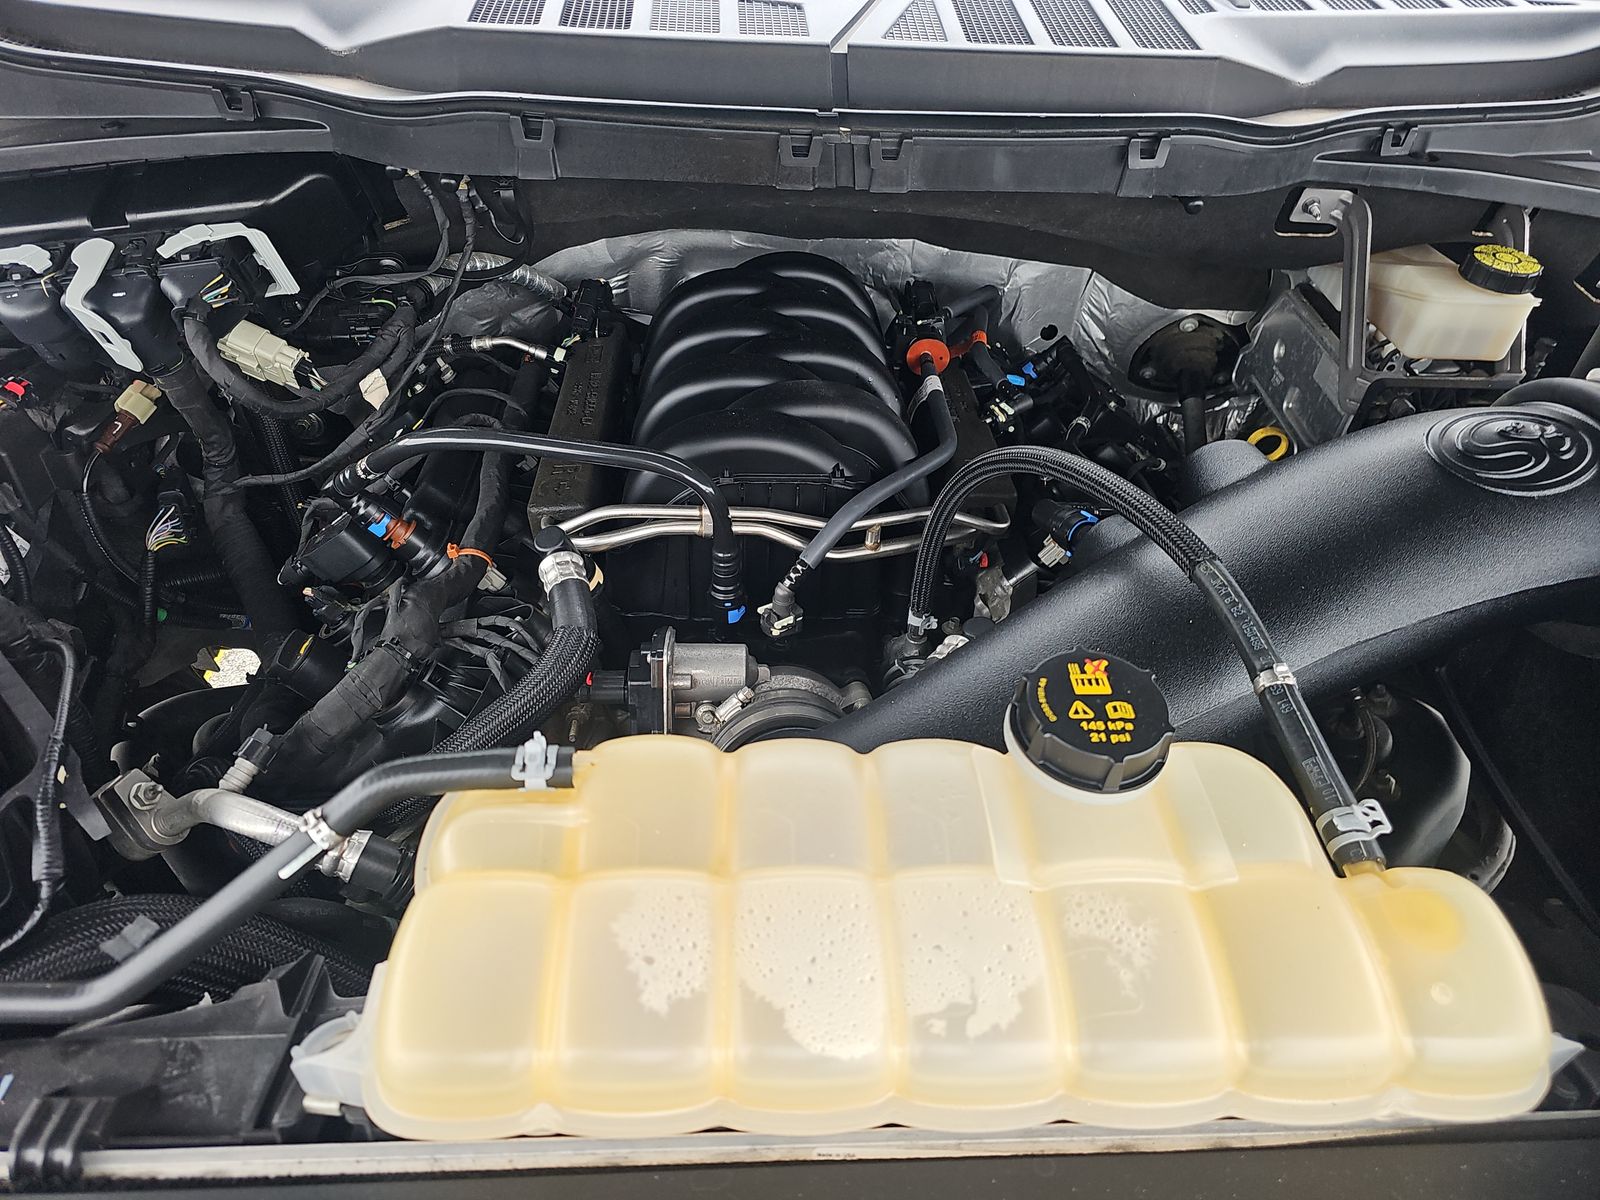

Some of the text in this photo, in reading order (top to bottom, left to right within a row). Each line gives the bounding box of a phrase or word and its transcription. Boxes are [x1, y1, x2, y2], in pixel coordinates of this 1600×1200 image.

[1107, 720, 1135, 731] kPa
[1089, 732, 1132, 745] 21 psi
